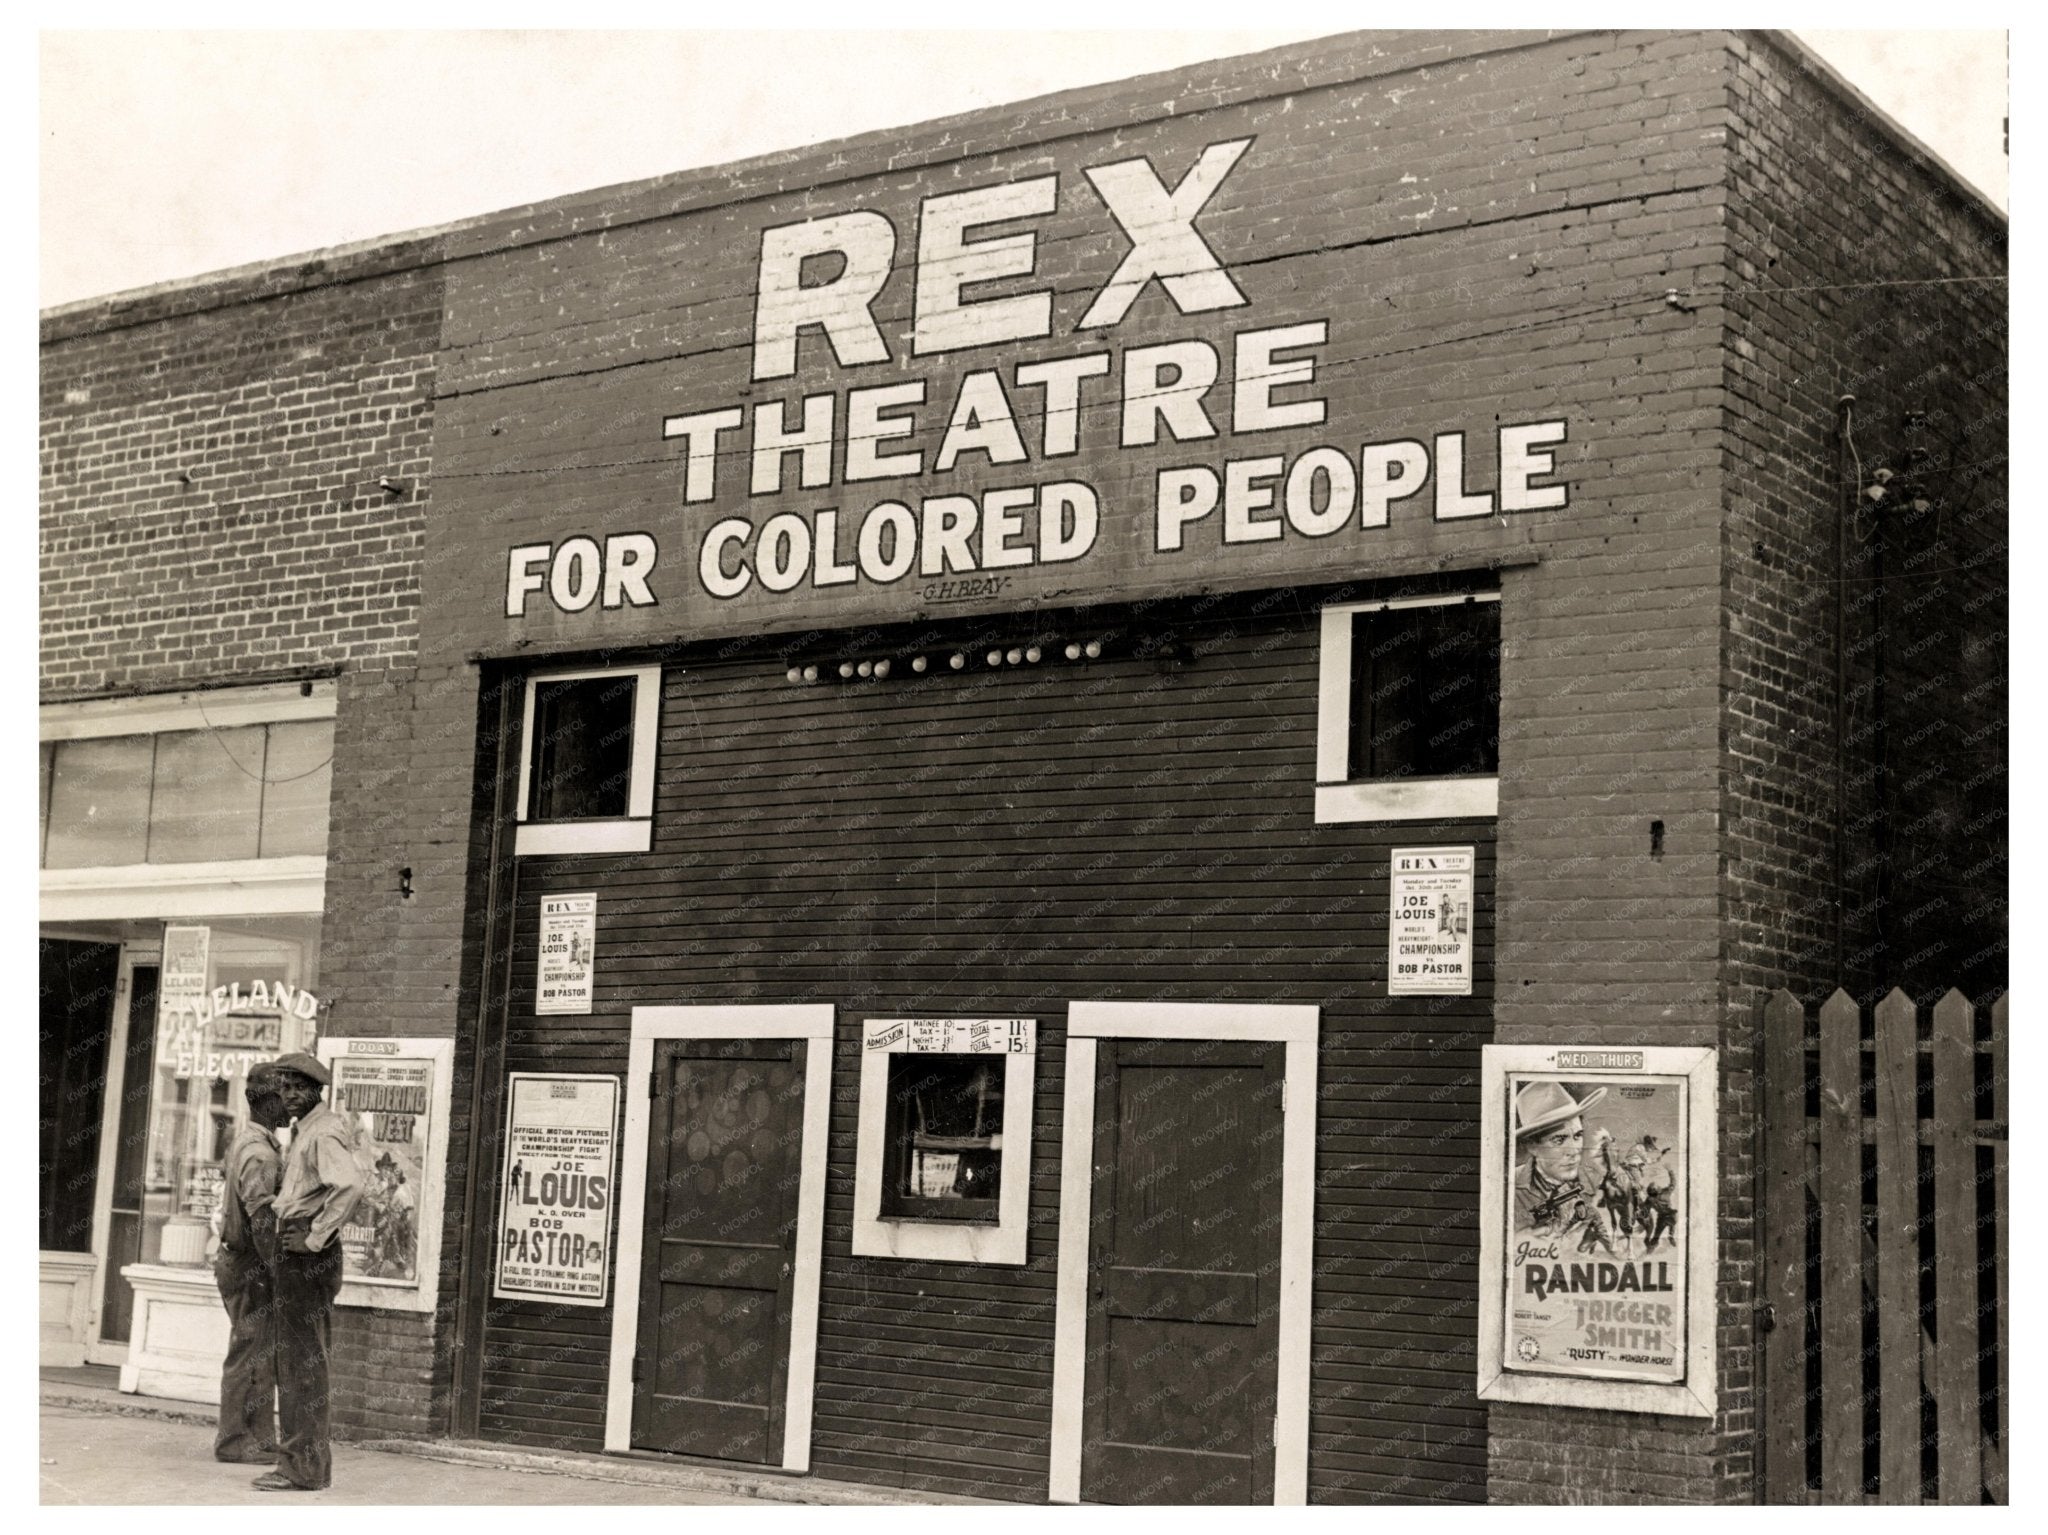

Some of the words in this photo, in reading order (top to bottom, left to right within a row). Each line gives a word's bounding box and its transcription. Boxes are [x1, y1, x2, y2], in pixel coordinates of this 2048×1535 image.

[751, 135, 1258, 384] REX
[663, 319, 1330, 506] THEATRE
[504, 531, 659, 619] FOR
[698, 480, 1099, 600] COLORED
[1154, 419, 1568, 554] PEOPLE
[1401, 858, 1437, 869] REX
[547, 902, 571, 913] REX
[1403, 896, 1428, 907] JOE
[1395, 909, 1436, 920] LOUIS
[547, 934, 563, 943] JOE
[542, 944, 568, 954] LOUIS
[1399, 944, 1461, 955] CHAMPIONSHIP
[1398, 964, 1418, 974] BOB
[1422, 963, 1462, 974] PASTOR
[164, 976, 205, 988] LELAND
[544, 972, 586, 982] CHAMPIONSHIP
[543, 989, 556, 998] BOB
[558, 988, 586, 997] PASTOR
[191, 979, 318, 1028] LELAND
[970, 1024, 990, 1035] TOTAL
[866, 1028, 905, 1047] ADMISSION
[350, 1043, 394, 1053] TODAY
[970, 1038, 991, 1052] TOTAL
[1560, 1053, 1588, 1066] WED
[1600, 1054, 1640, 1067] THURS
[345, 1083, 426, 1115] THUNDERING
[373, 1114, 416, 1143] WEST
[547, 1128, 573, 1136] MOTION
[576, 1129, 609, 1137] PICTURES
[521, 1144, 575, 1152] CHAMPIONSHIP
[579, 1145, 600, 1153] FIGHT
[551, 1161, 584, 1172] JOE
[522, 1171, 607, 1210] LOUIS
[529, 1218, 564, 1229] BOB
[505, 1228, 585, 1268] PASTOR
[1514, 1241, 1559, 1267] Jack
[542, 1269, 565, 1279] DYNAMIC
[581, 1272, 600, 1281] ACTION
[503, 1277, 532, 1287] HIGHLIGHTS
[533, 1280, 552, 1289] SHOWN
[561, 1282, 576, 1291] SLOW
[578, 1284, 600, 1293] MOTION
[1525, 1261, 1673, 1302] RANDALL
[1619, 1354, 1650, 1365] WONDER
[1650, 1356, 1674, 1367] HORSE
